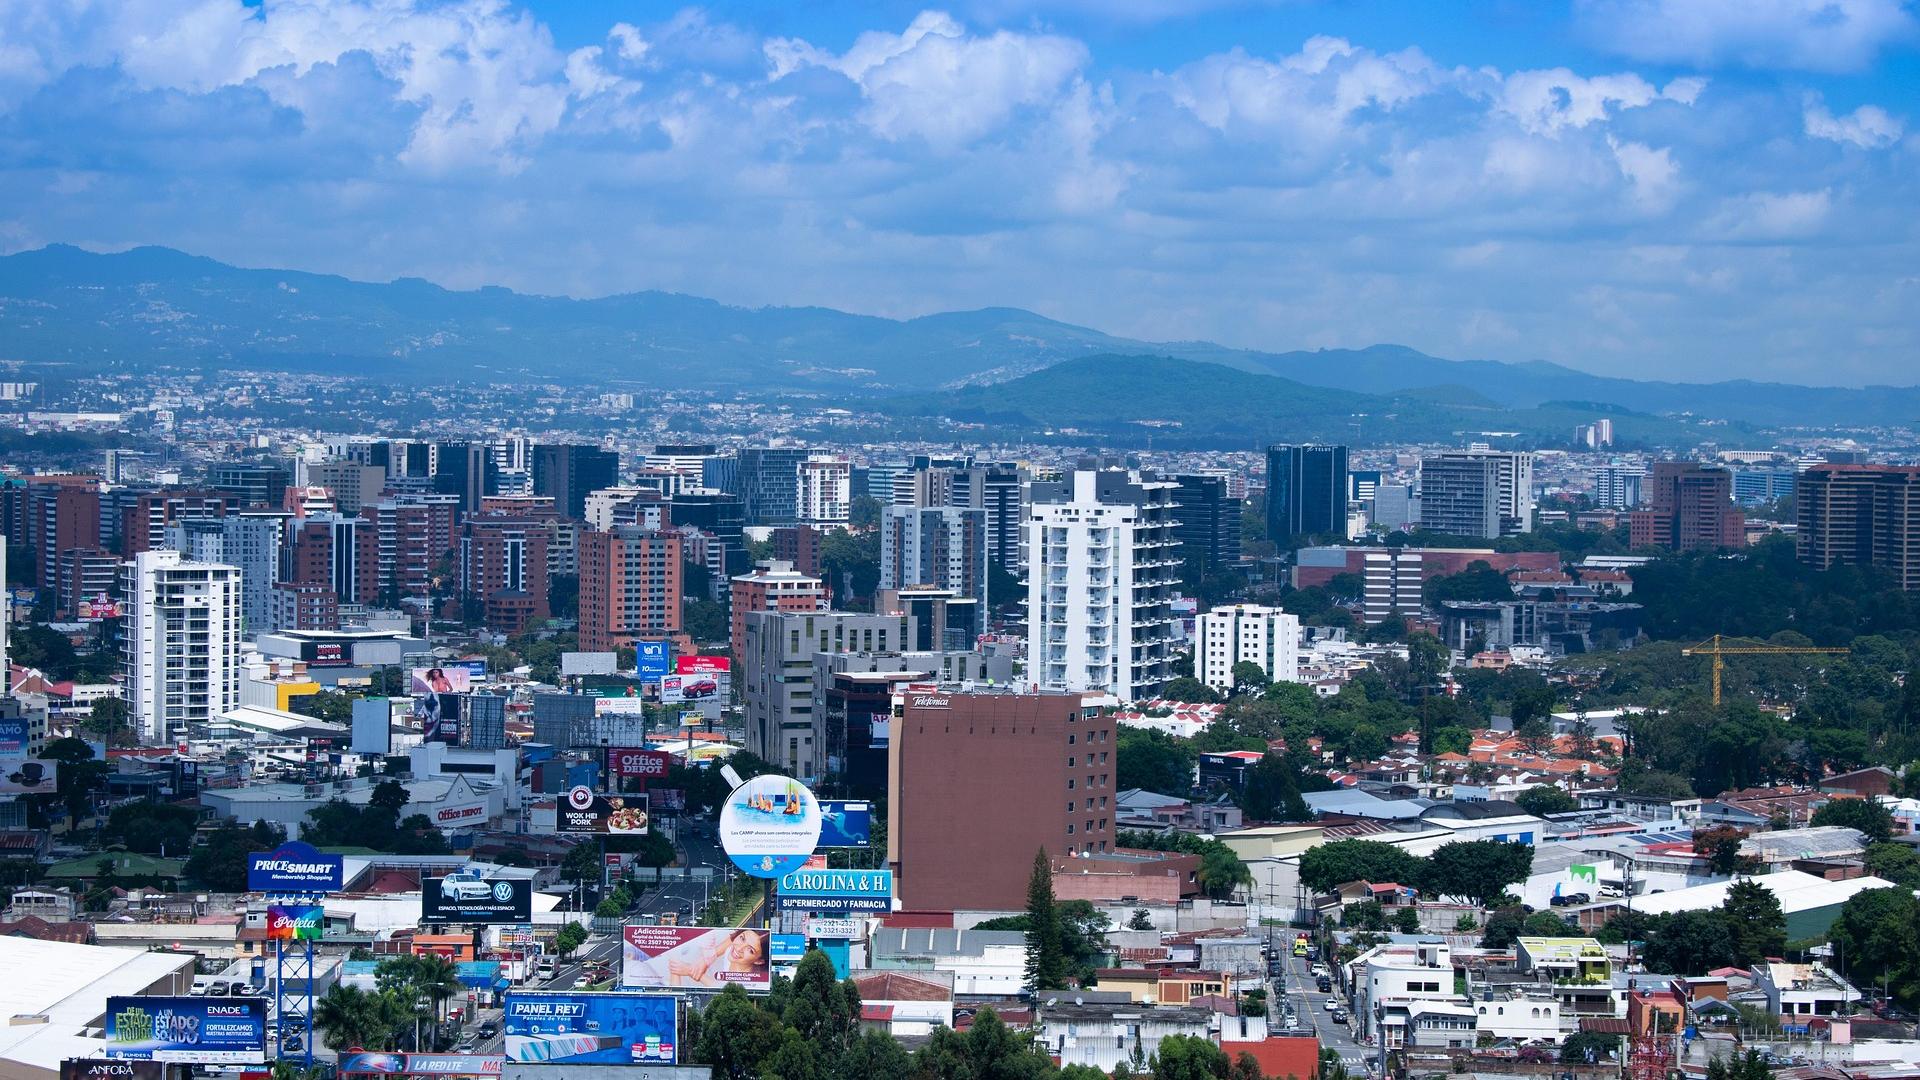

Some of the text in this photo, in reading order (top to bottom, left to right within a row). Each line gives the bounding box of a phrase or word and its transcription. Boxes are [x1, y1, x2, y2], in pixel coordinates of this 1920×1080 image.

[912, 696, 949, 707] Telefónica
[621, 755, 664, 766] Office
[623, 765, 663, 774] DEPOT
[438, 807, 483, 820] Office DEPOT
[254, 861, 333, 874] PRICESMART
[782, 874, 887, 891] CAROLINA & H.
[849, 900, 886, 909] FARMACIA
[273, 917, 316, 928] Paleta
[207, 1006, 241, 1014] ENADE
[516, 1004, 579, 1014] PANEL REY
[116, 1013, 153, 1028] ESTADO
[155, 1015, 199, 1031] ESTADO
[414, 1061, 463, 1070] LA RED LTE
